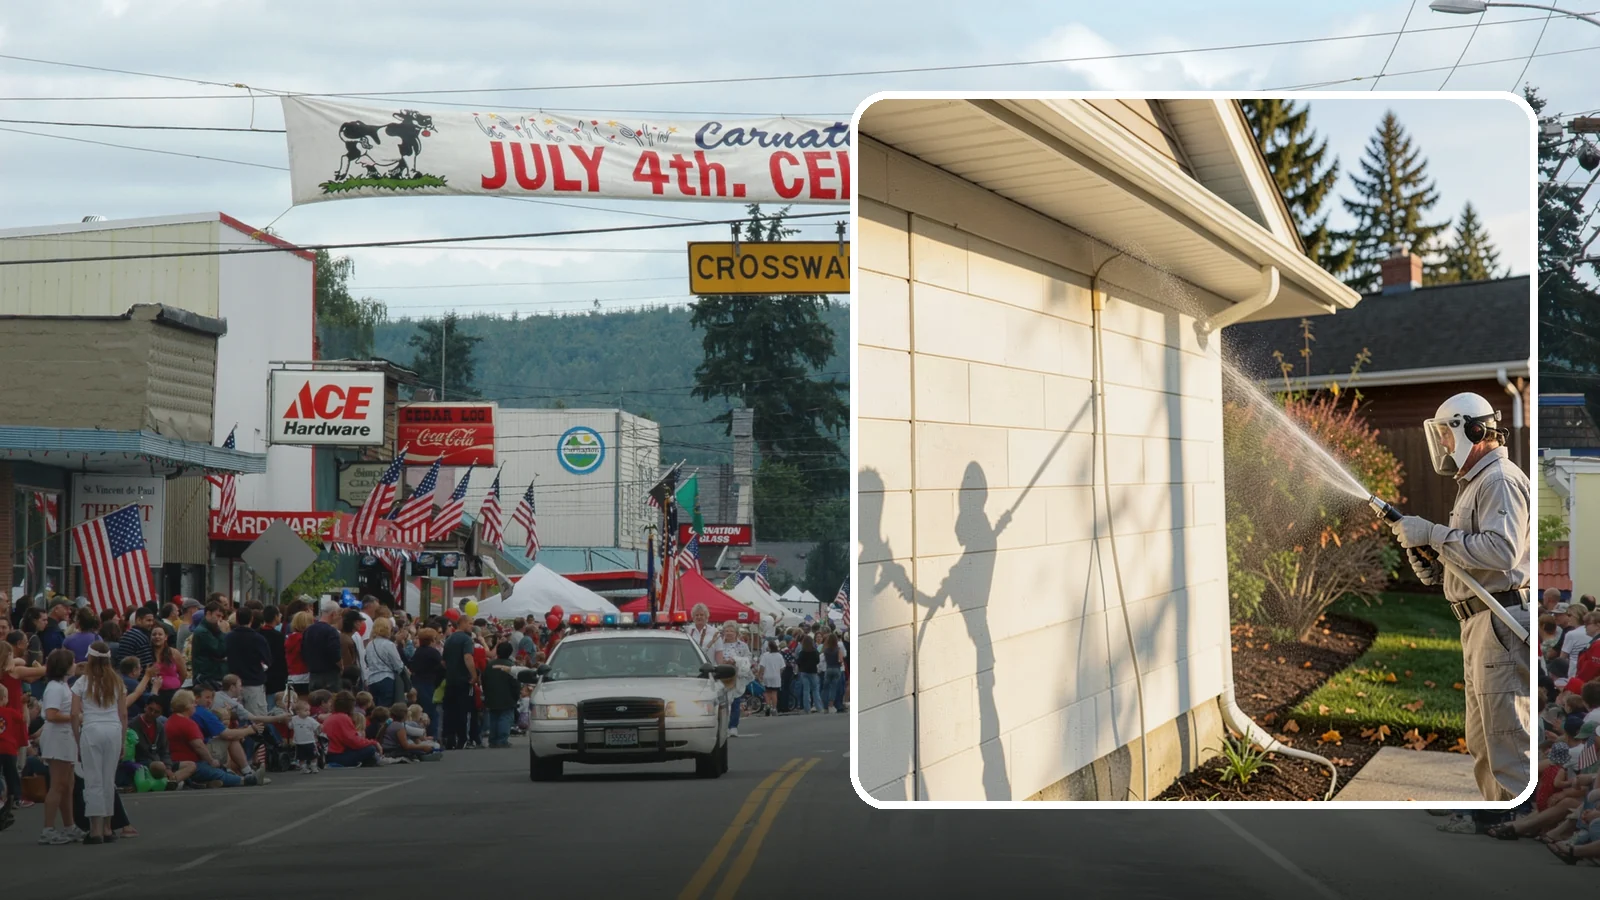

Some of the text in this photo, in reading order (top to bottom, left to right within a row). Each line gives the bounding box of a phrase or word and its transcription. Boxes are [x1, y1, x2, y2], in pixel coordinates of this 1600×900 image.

[481, 140, 604, 192] JULY
[632, 149, 746, 198] 4th.
[697, 254, 850, 280] CROSSWA
[283, 380, 373, 419] ACE
[406, 409, 452, 422] CEDAR
[283, 421, 370, 436] Hardware
[96, 485, 124, 494] Vincent
[126, 486, 136, 494] de
[138, 486, 155, 495] Paul
[688, 526, 741, 535] CRNATION
[699, 535, 730, 543] GLASS
